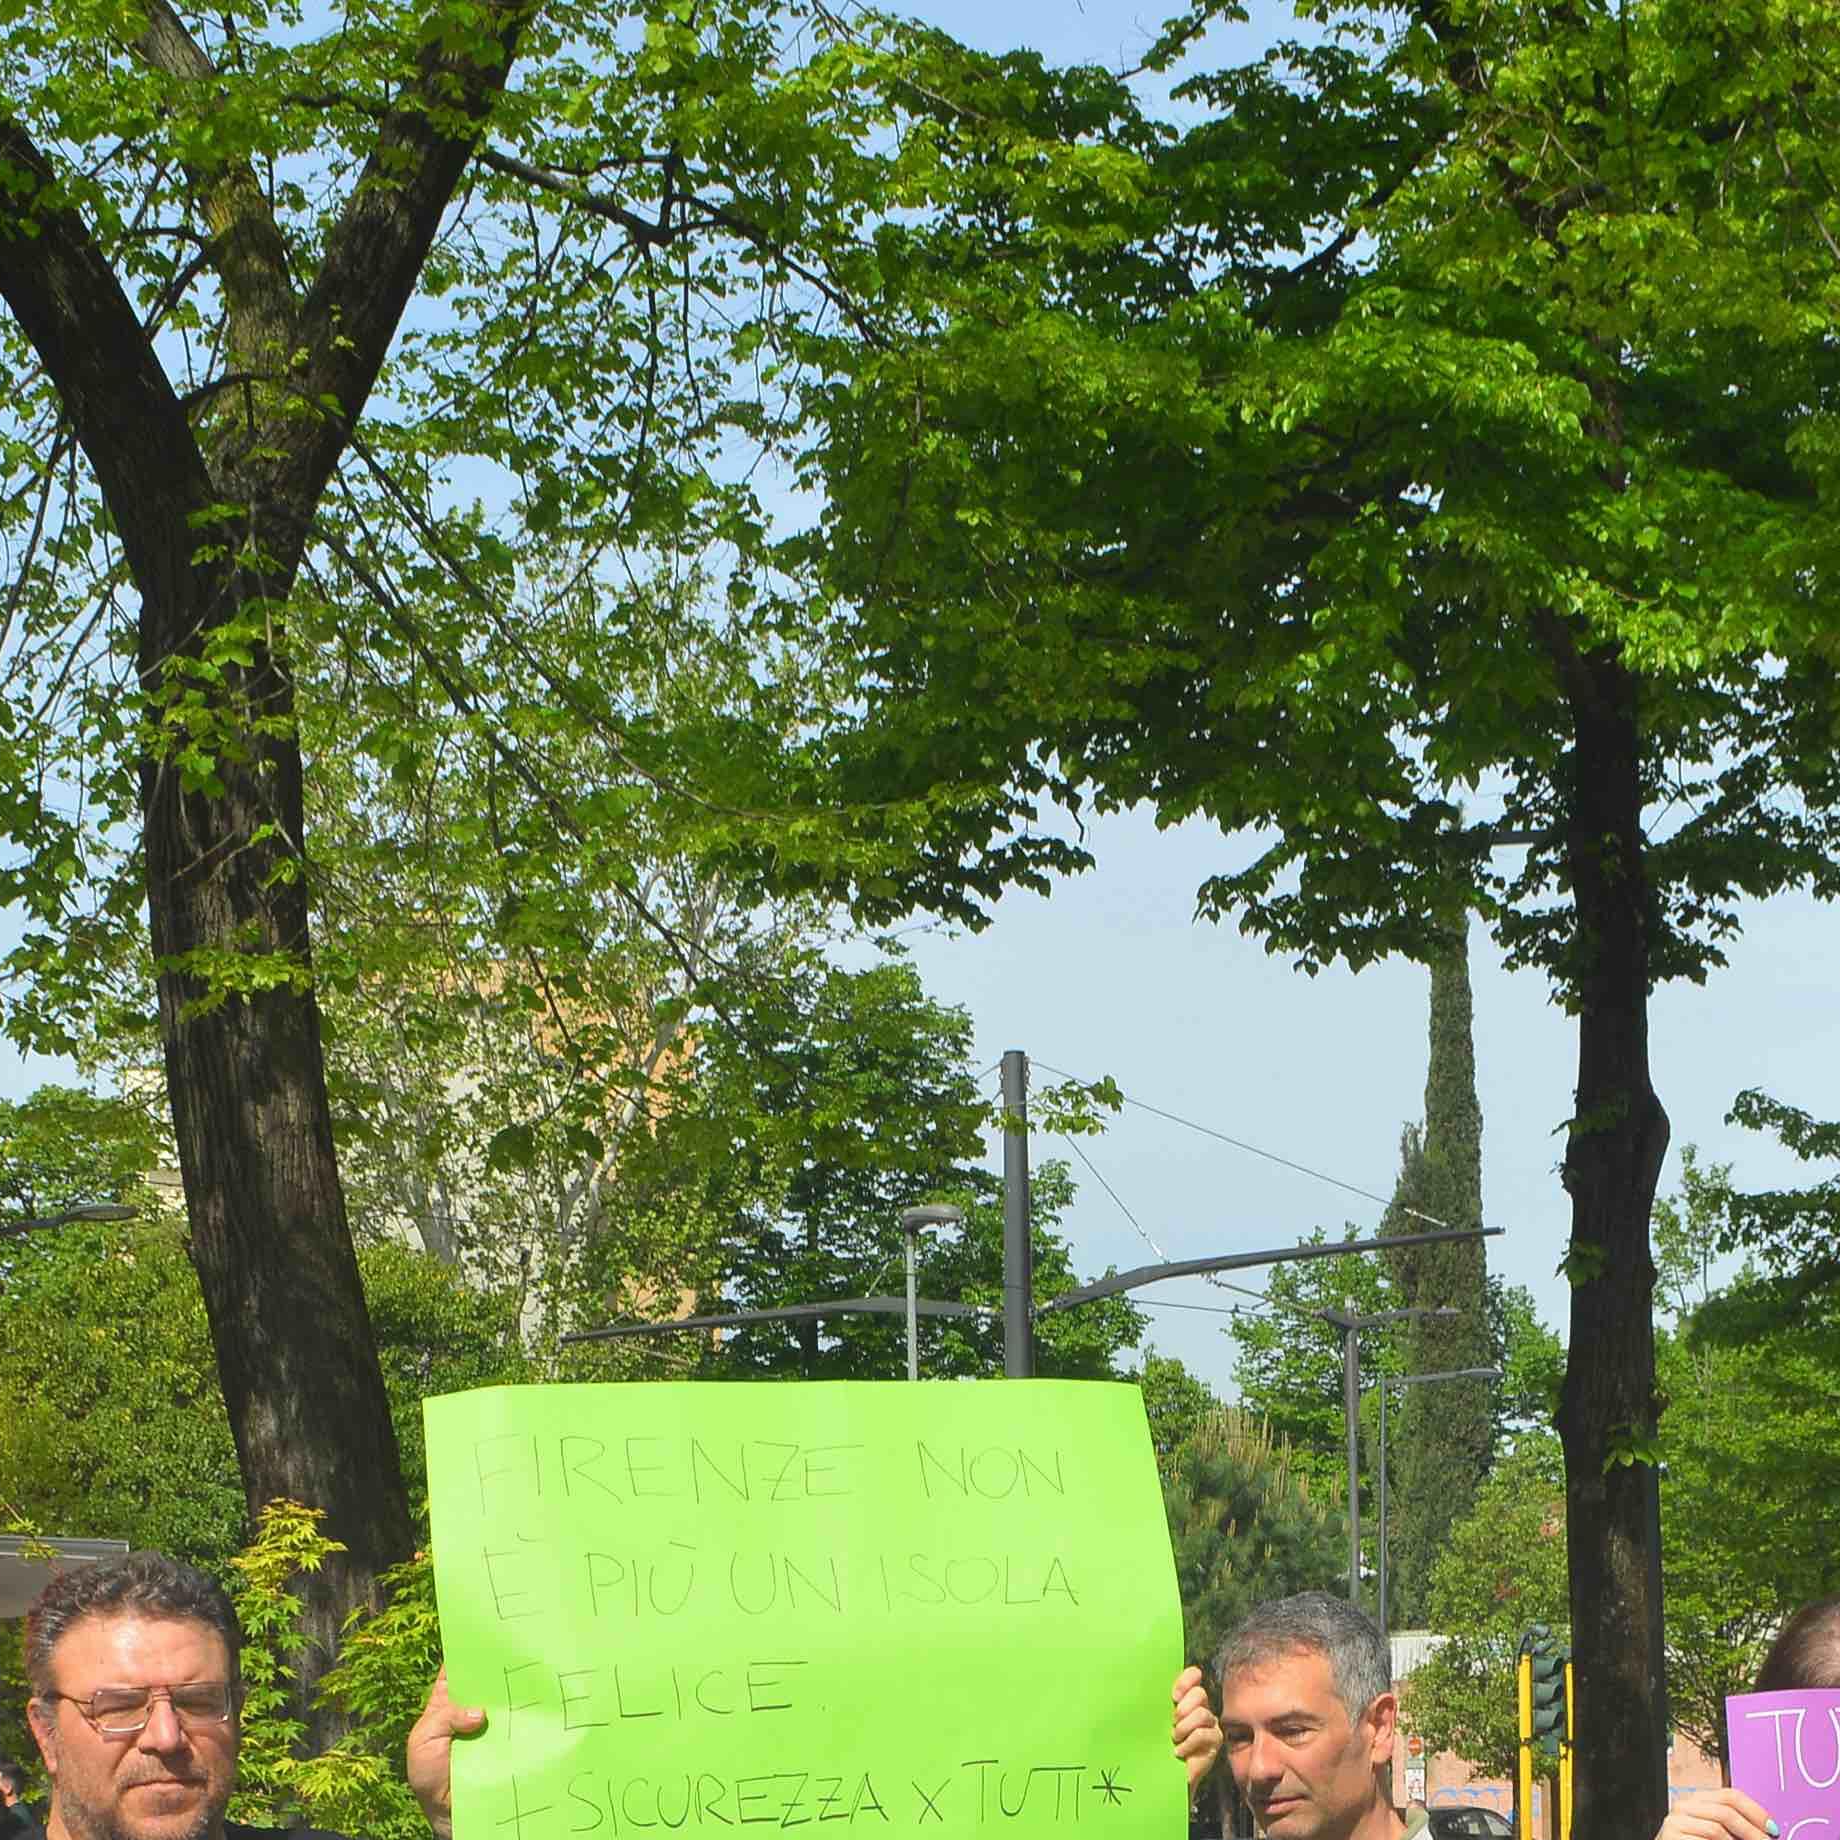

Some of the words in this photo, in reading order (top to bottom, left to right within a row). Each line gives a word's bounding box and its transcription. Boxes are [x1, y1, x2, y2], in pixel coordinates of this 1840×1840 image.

[474, 1435, 865, 1513] FIRENZE
[917, 1439, 1065, 1500] NON
[585, 1540, 697, 1617] PIÙ
[730, 1551, 844, 1614] UN
[879, 1552, 1081, 1611] ISOLA
[570, 1772, 889, 1837] SICUREZZA
